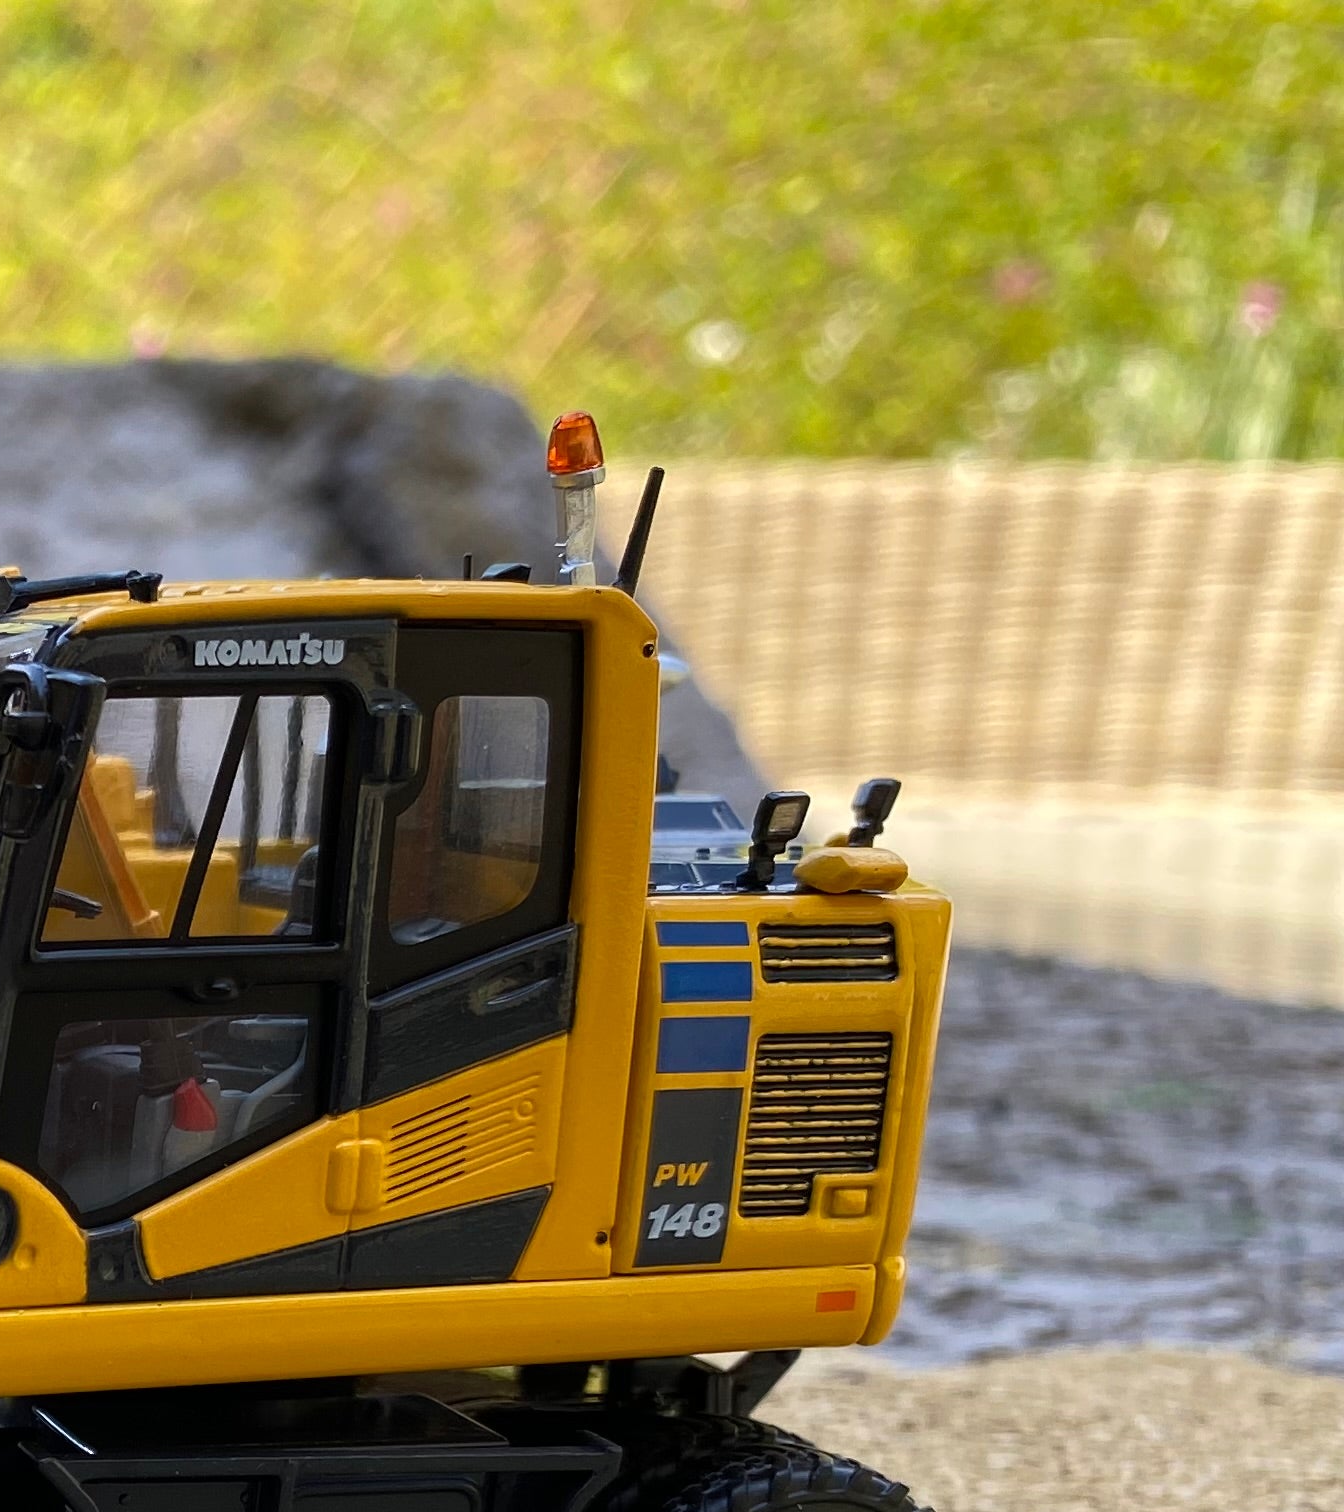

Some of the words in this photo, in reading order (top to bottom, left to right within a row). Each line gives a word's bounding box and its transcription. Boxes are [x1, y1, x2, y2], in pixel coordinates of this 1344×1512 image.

[194, 632, 345, 667] KOMATSU
[652, 1161, 709, 1188] PW
[647, 1203, 725, 1240] 148
